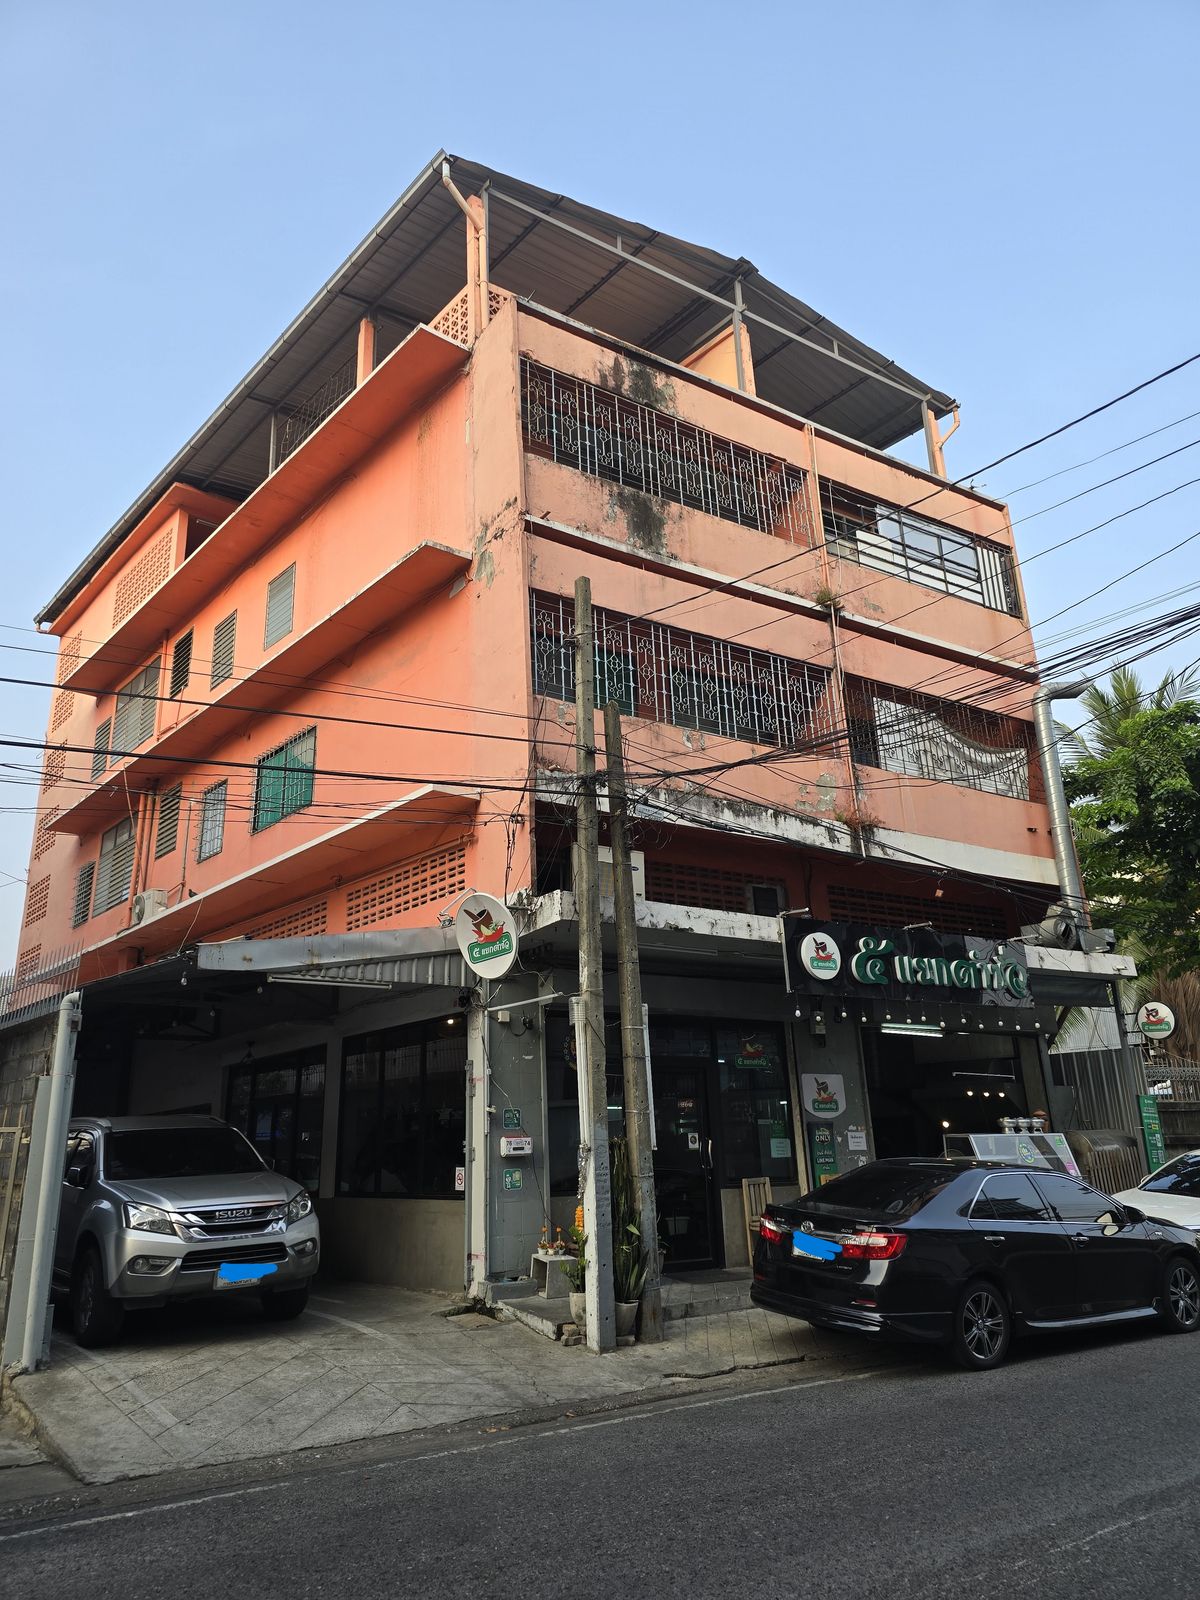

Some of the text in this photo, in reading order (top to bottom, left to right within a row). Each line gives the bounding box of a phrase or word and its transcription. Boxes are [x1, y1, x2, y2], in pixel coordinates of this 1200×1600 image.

[851, 936, 893, 985] ๕
[815, 1134, 831, 1142] ONLY
[215, 1208, 252, 1219] ISUZU
